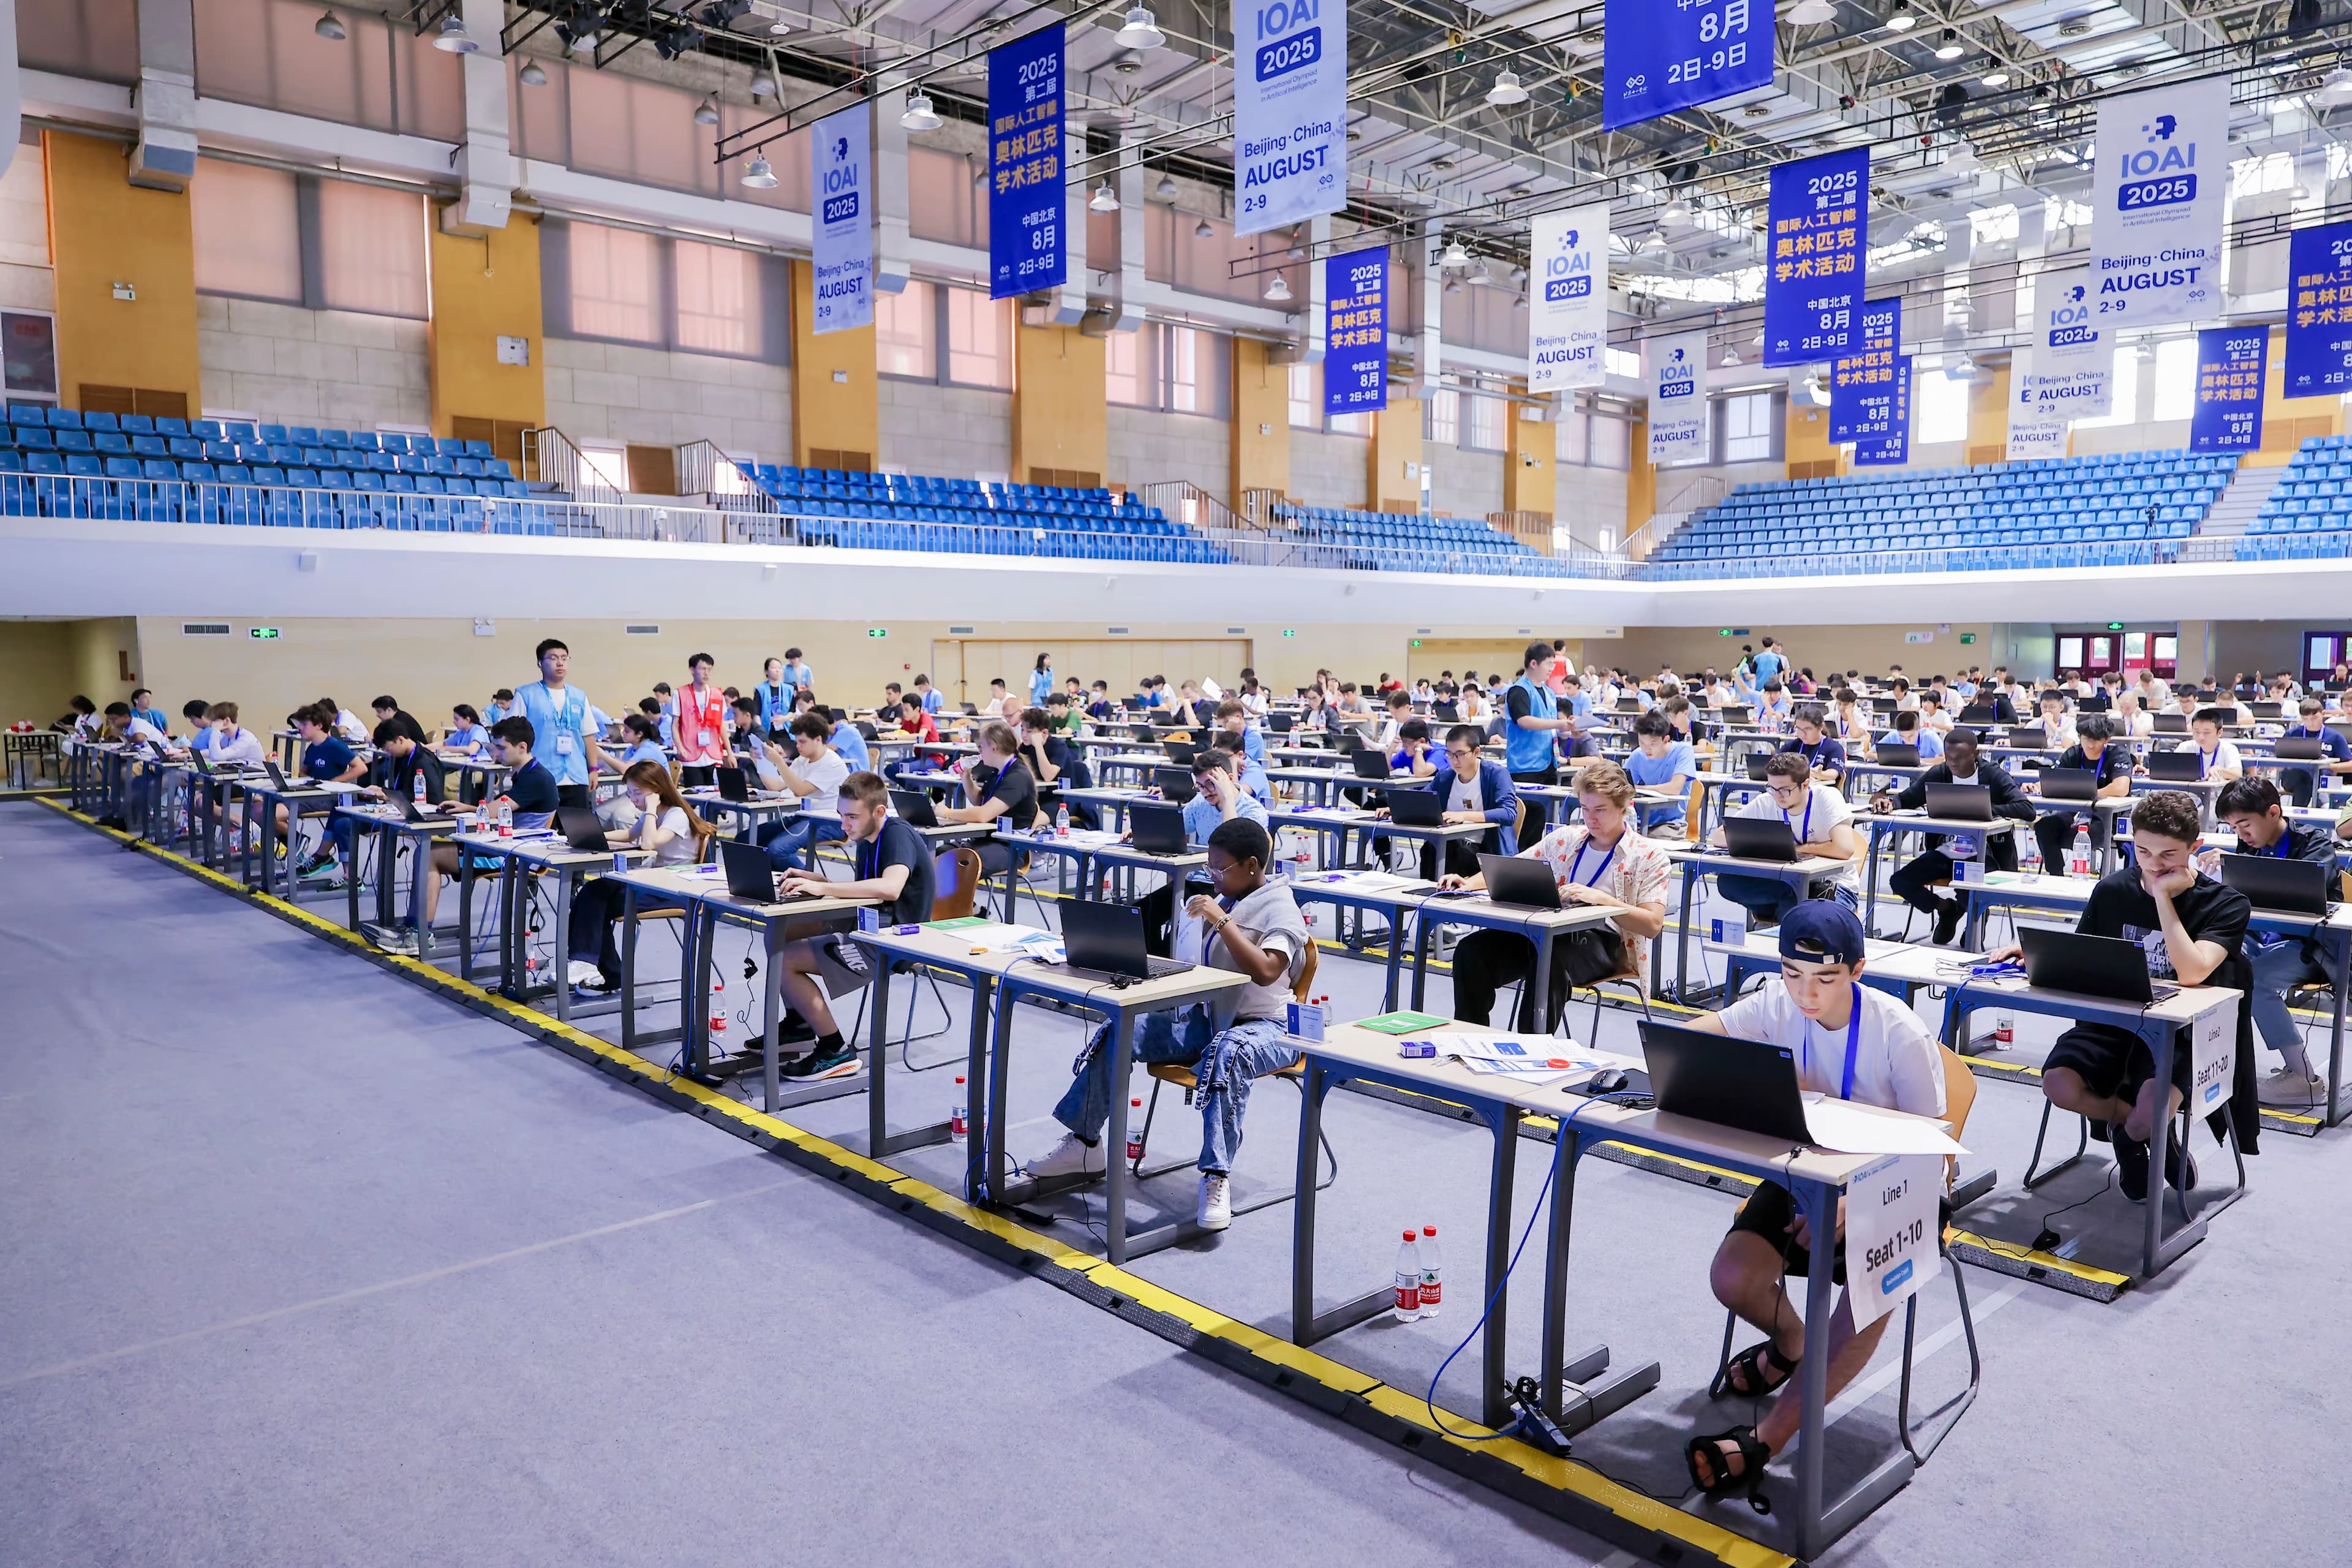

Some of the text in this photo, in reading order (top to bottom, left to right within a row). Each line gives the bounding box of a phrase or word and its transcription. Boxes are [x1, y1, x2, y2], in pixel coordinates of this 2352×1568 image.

[1258, 0, 1318, 40] IOAI
[1699, 0, 1749, 42] 8月
[1263, 35, 1314, 74] 2025
[1667, 42, 1746, 84] 2日-9日
[1019, 53, 1057, 85] 2025
[1025, 77, 1057, 103] 第二届
[1261, 69, 1317, 93] International Olympiad
[1267, 88, 1287, 100] Artificial
[1288, 79, 1317, 94] Intelligence
[995, 99, 1057, 135] 国际人工智能
[995, 124, 1058, 166] 奥林匹克
[1245, 145, 1329, 189] AUGUST
[2122, 143, 2195, 178] IOAI
[824, 164, 857, 194] IOAI
[995, 154, 1058, 194] 学术活动
[1808, 170, 1857, 195] 2025
[1816, 190, 1856, 210] 第二届
[2127, 179, 2188, 206] 2025
[827, 197, 855, 219] 2025
[1245, 194, 1266, 213] 2-9
[2123, 206, 2191, 221] International Olympiad
[1022, 207, 1055, 228] 中国北京
[1776, 208, 1856, 234] 国际人工智能
[2130, 218, 2154, 227] Artificial
[2155, 214, 2190, 224] Intelligence
[1032, 225, 1055, 250] 8月
[1776, 228, 1856, 258] 奥林匹克
[2331, 239, 2352, 255] 20
[1019, 253, 1054, 275] 2日-9日
[1351, 263, 1381, 281] 2025
[1547, 252, 1589, 277] IOAI
[1775, 252, 1855, 282] 学术活动
[819, 277, 862, 300] AUGUST
[1550, 279, 1587, 298] 2025
[2100, 267, 2201, 294] AUGUST
[2298, 270, 2352, 287] 国际人工
[1807, 295, 1851, 311] 中国北京
[2100, 300, 2125, 313] 2-9
[2297, 286, 2352, 308] 奥林匹
[819, 306, 831, 317] 2-9
[1331, 308, 1381, 331] 奥林匹克
[1820, 309, 1850, 330] 8月
[1863, 312, 1893, 326] 2025
[2051, 306, 2087, 326] IOA
[2297, 306, 2352, 328] 学术活
[1331, 327, 1381, 349] 学术活动
[1801, 333, 1848, 349] 2日-9日
[2054, 328, 2093, 344] 2025
[2225, 338, 2260, 351] 2025
[2330, 341, 2352, 351] 中国
[1536, 345, 1594, 364] AUGUST
[1837, 351, 1893, 371] 奥林匹克
[2343, 353, 2352, 367] 8
[1352, 360, 1379, 372] 中国北京
[1536, 369, 1551, 379] 2-9
[1660, 364, 1692, 381] IOAI
[1360, 372, 1379, 387] 8月
[1837, 368, 1892, 386] 学术活动
[2324, 372, 2352, 383] 2日-
[1349, 390, 1378, 402] 2日-9日
[1663, 383, 1691, 396] 2025
[2039, 383, 2101, 400] AUGUST
[2200, 387, 2257, 402] 学术活动
[1860, 396, 1890, 407] 中国北京
[2038, 404, 2055, 413] 2-9
[1868, 405, 1889, 420] 8月
[1653, 429, 1696, 443] AUGUST
[1856, 421, 1888, 433] 2日-9日
[2013, 432, 2058, 442] AUGUST
[2231, 421, 2252, 434] 8月
[1885, 439, 1901, 449] 8月
[2218, 434, 2250, 444] 2日-9日
[837, 943, 869, 971] NIKE
[2198, 1055, 2228, 1087] Seat 11-20
[1883, 1179, 1907, 1205] Line 1
[1866, 1219, 1922, 1273] Seat 1-10
